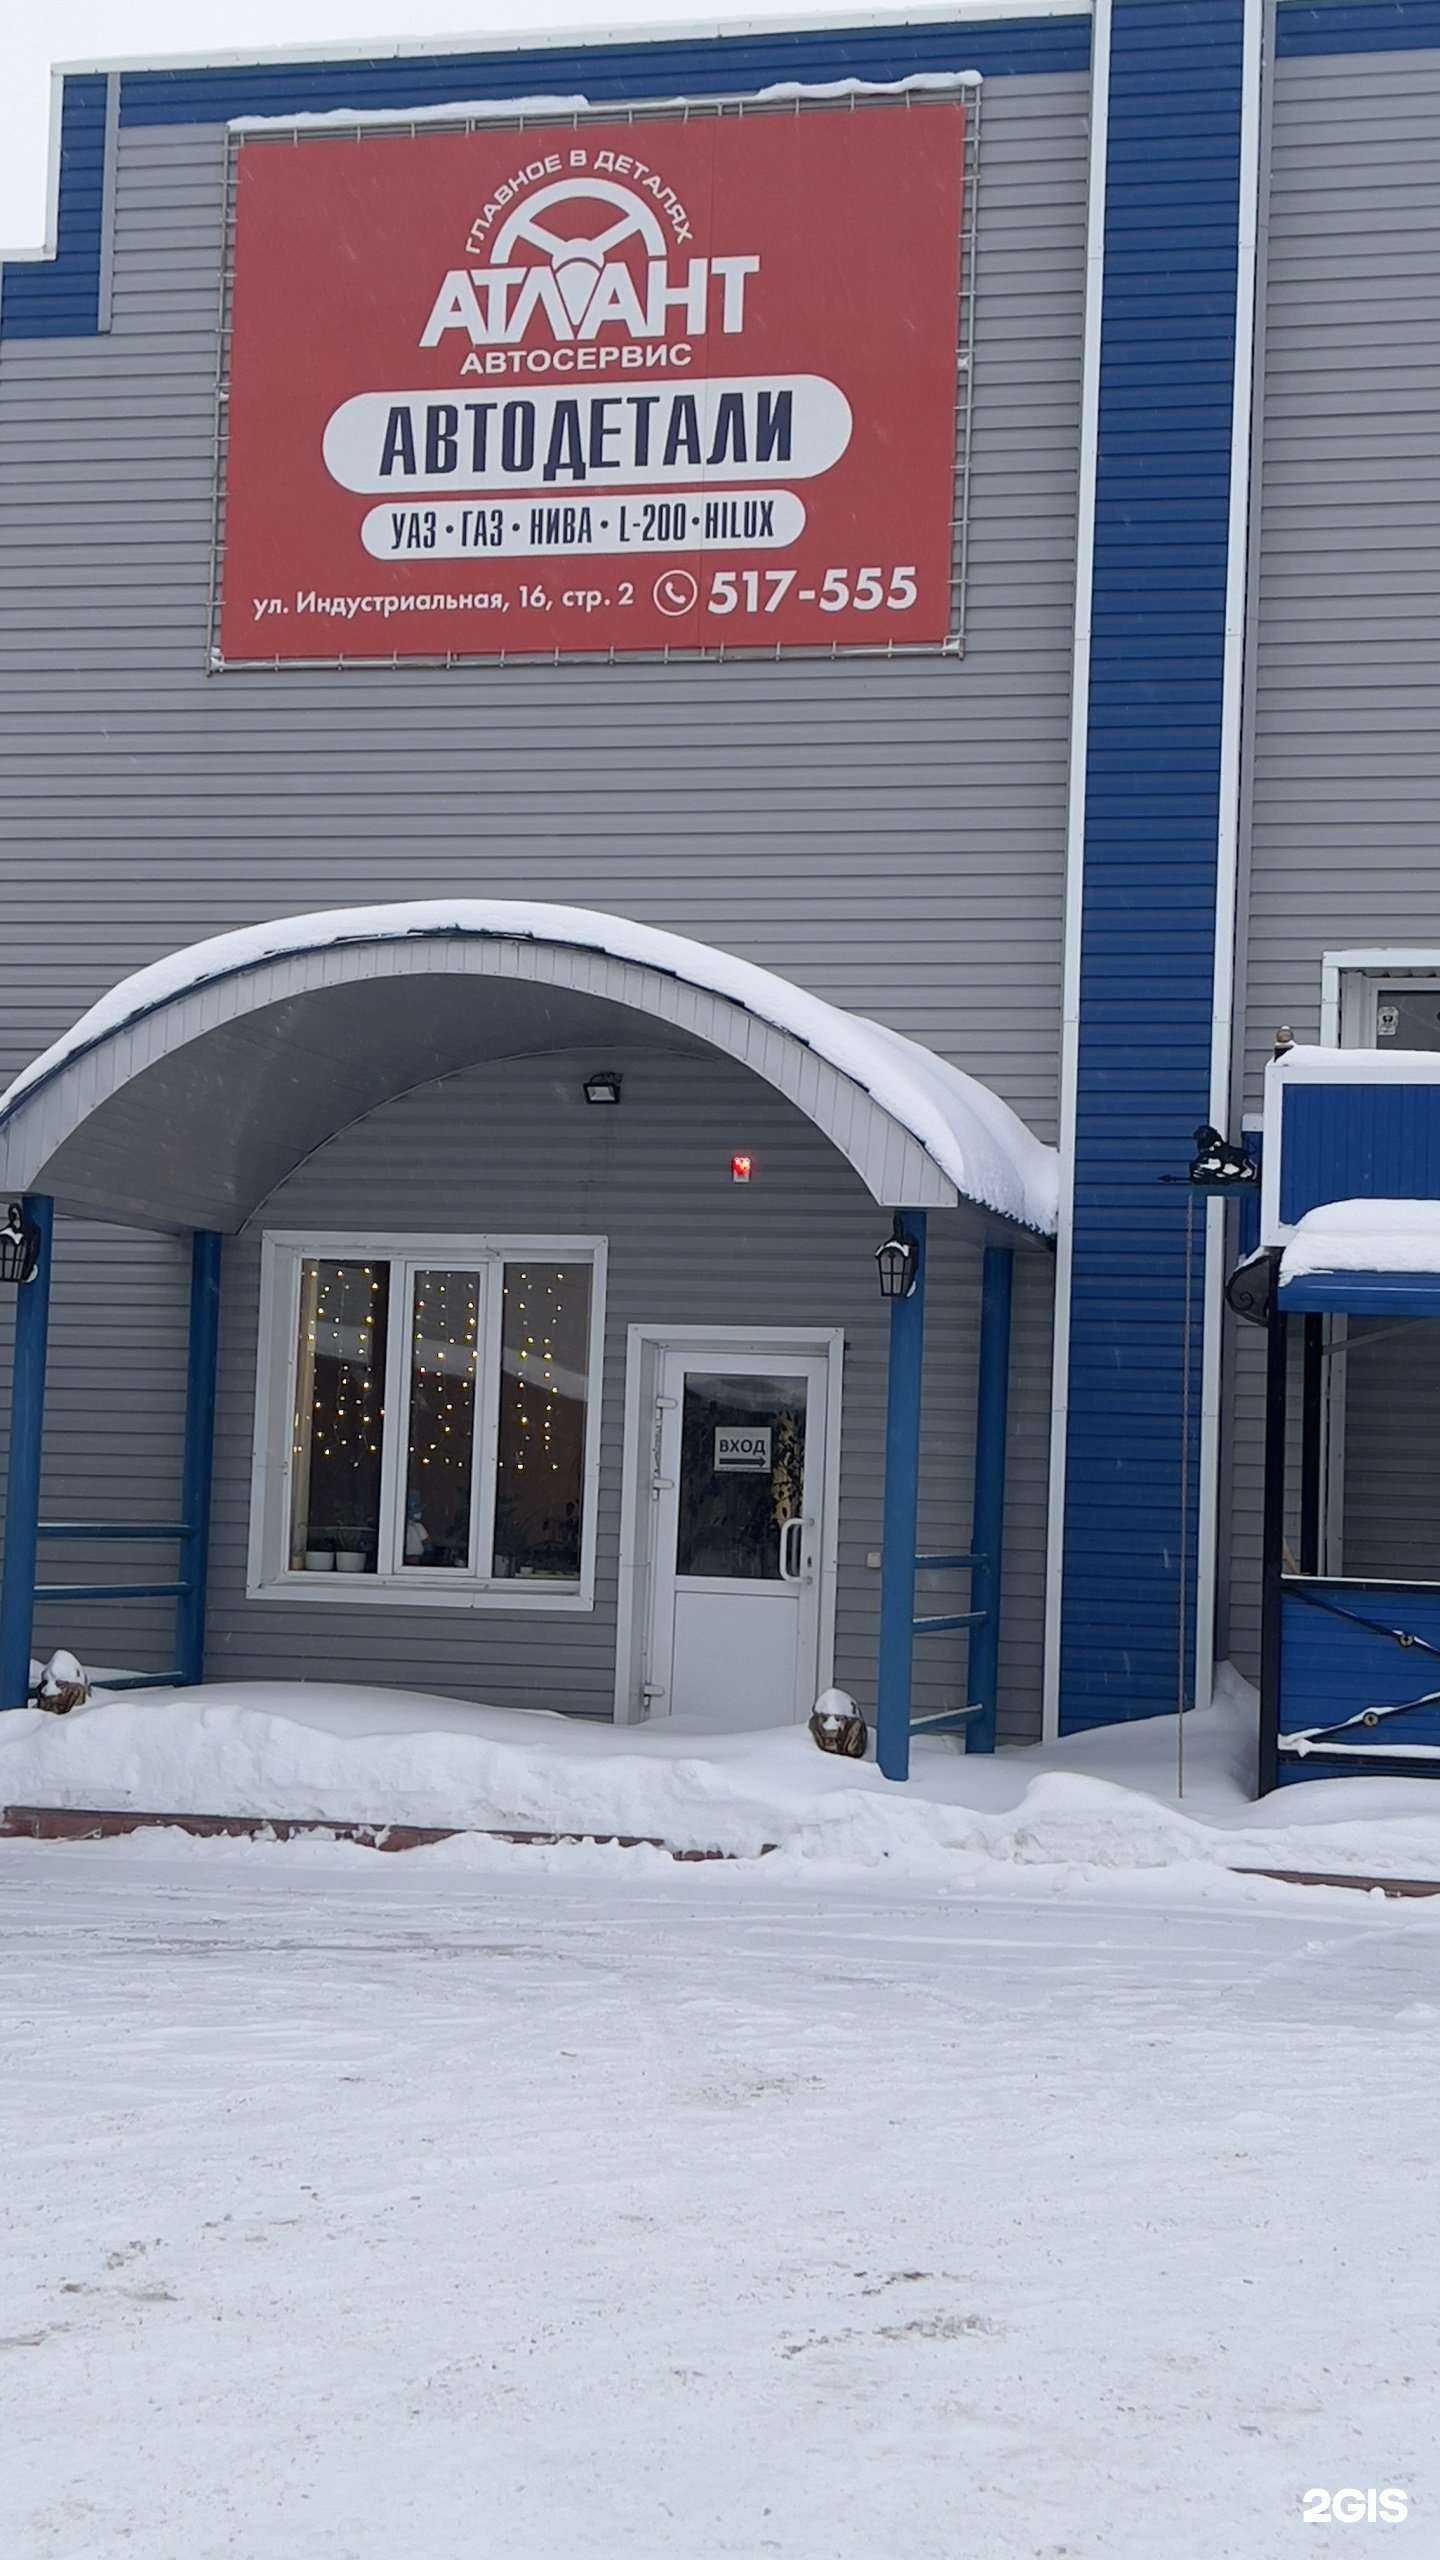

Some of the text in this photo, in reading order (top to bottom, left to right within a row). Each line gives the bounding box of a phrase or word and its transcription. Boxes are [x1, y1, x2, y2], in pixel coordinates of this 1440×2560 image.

[465, 149, 694, 255] ГЛАВНОЕ В ДЕТАЛЯХ
[418, 255, 761, 348] АТЛАНТ
[460, 343, 692, 376] АВТОСЕРВИС
[378, 390, 794, 482] АВТОДЕТАЛИ
[391, 501, 775, 550] УАЗ ГАЗ НИВА L-200 HILUX
[253, 582, 635, 621] ул. Индустриальная, 16, стр. 2
[707, 565, 918, 615] 517-555
[719, 1439, 766, 1456] ВХОД
